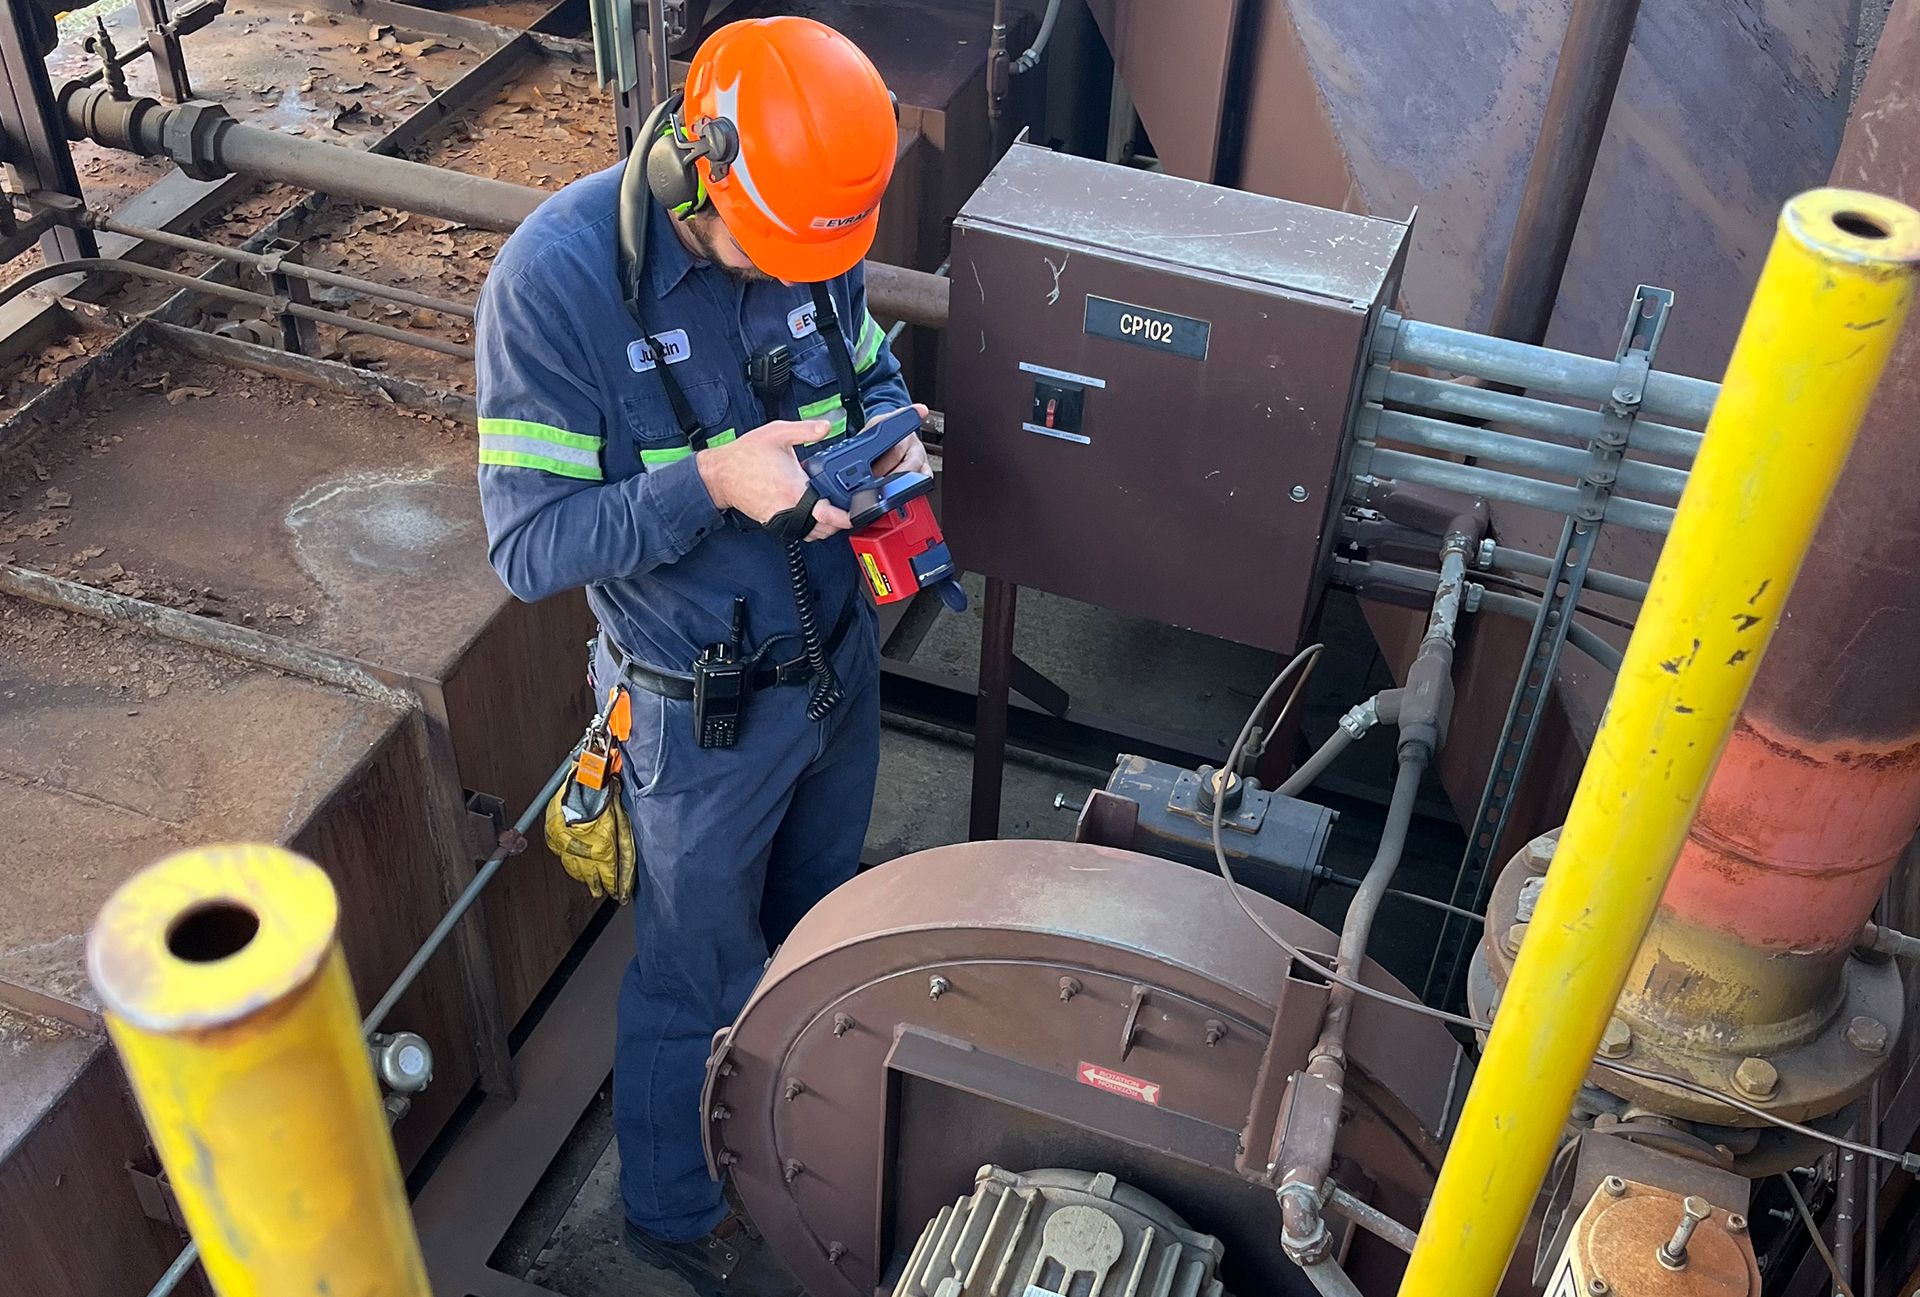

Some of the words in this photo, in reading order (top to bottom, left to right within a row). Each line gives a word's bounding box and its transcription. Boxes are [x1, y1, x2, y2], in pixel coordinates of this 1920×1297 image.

[1120, 313, 1173, 344] CP102
[639, 342, 680, 363] Juin
[1097, 1080, 1138, 1097] ROTATION
[1099, 1070, 1140, 1088] ROTATION
